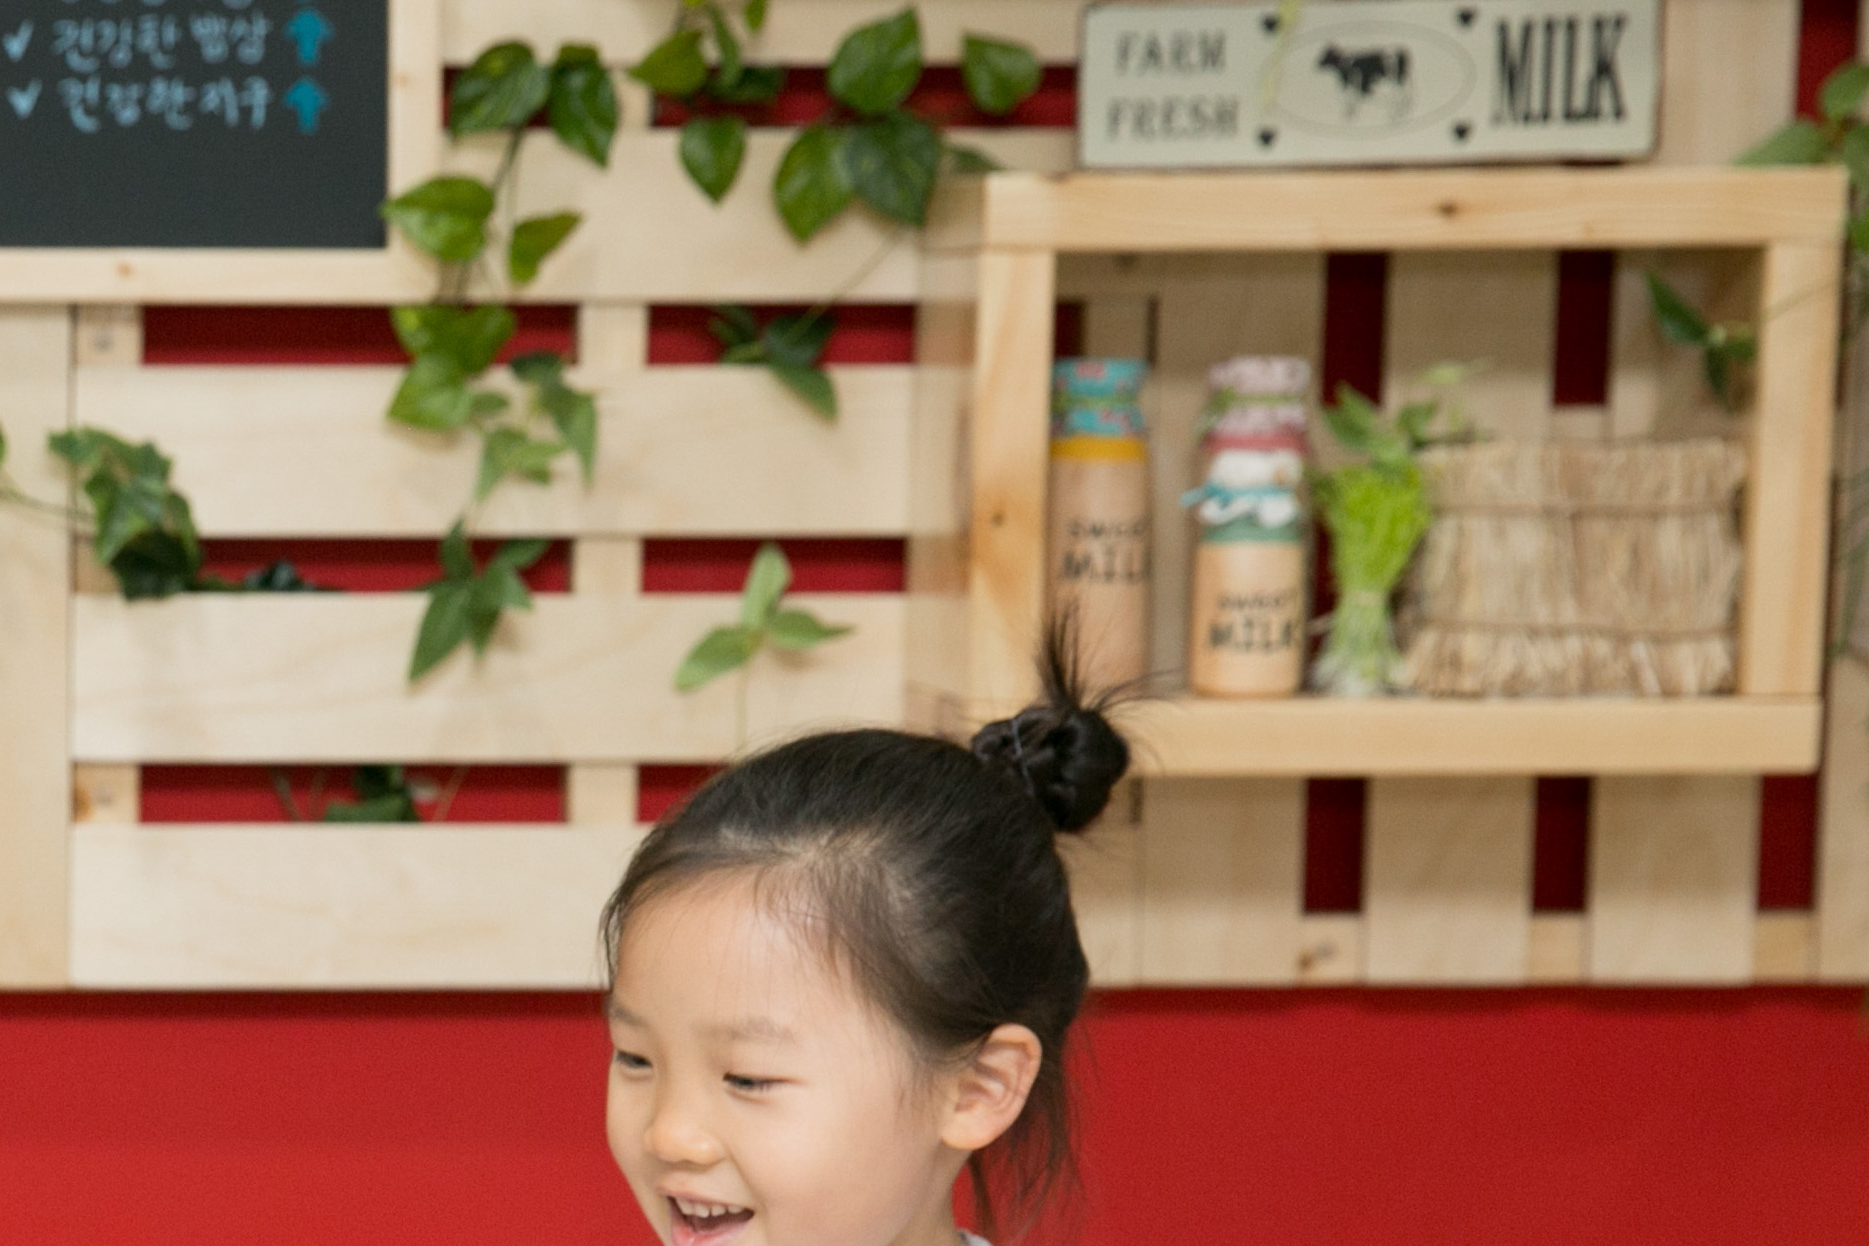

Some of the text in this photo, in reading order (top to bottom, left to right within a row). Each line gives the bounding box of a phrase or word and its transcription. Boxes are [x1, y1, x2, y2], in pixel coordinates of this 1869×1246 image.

[51, 9, 274, 71] 건강한 밥상
[1115, 29, 1228, 77] FARM
[1492, 14, 1628, 126] MILK
[1105, 95, 1241, 143] FRESH
